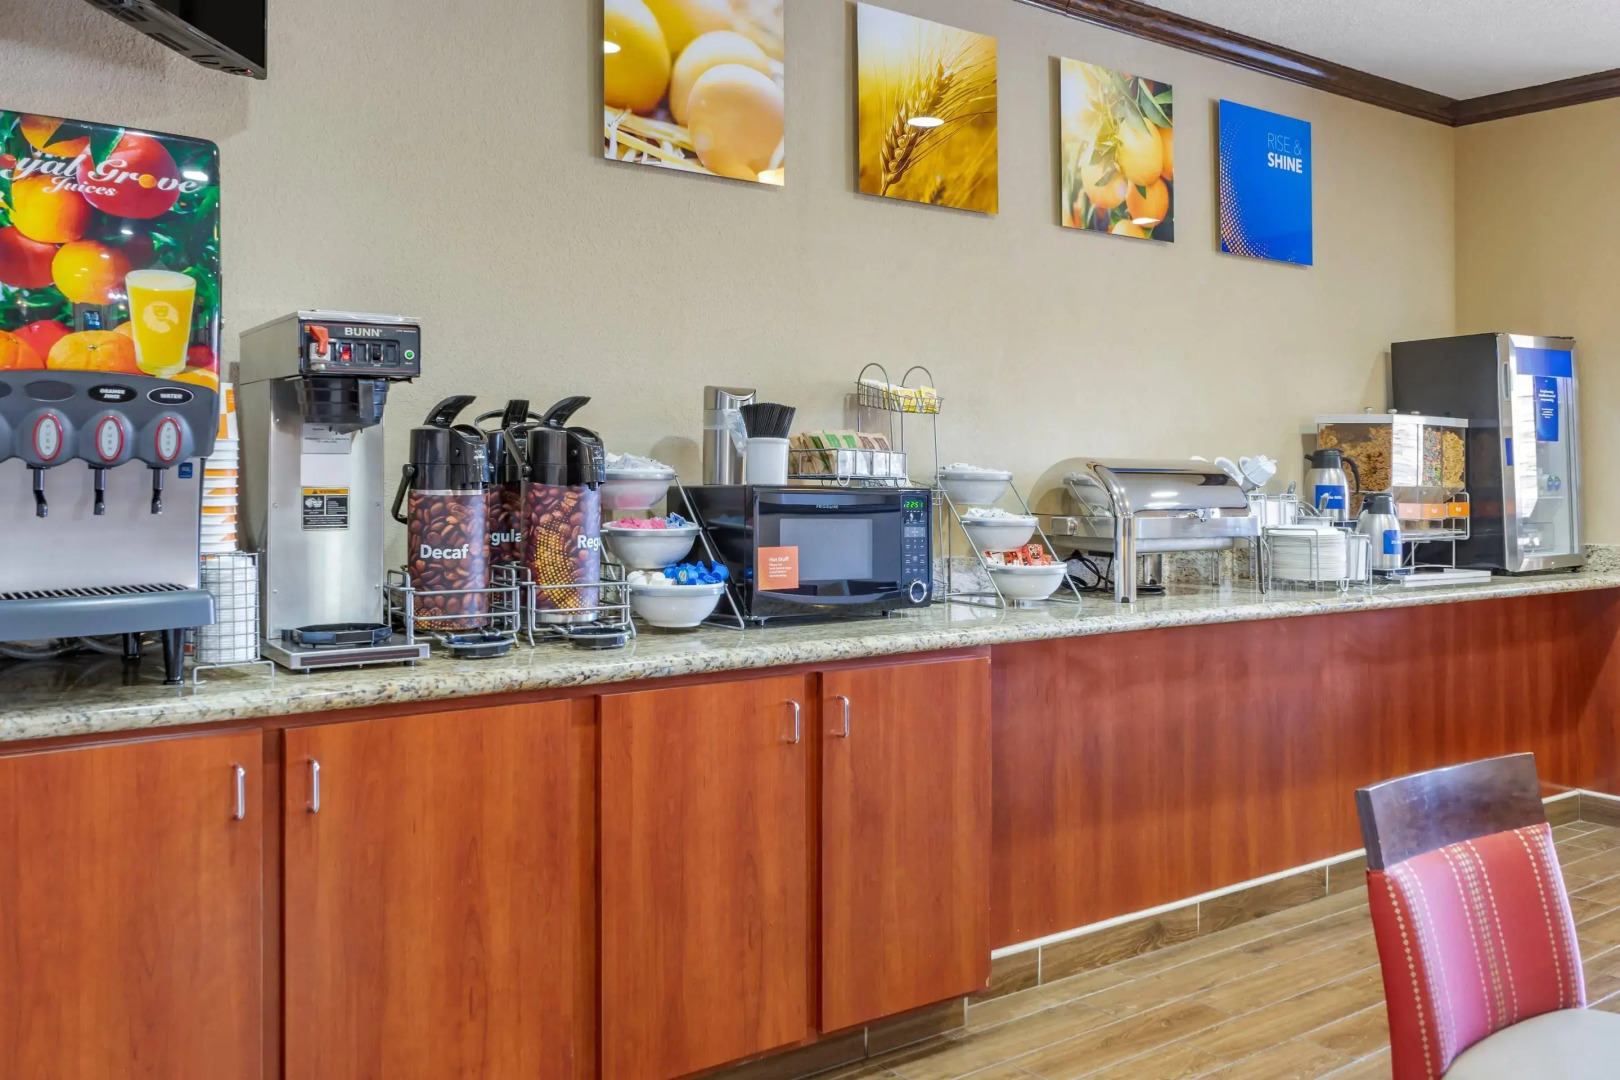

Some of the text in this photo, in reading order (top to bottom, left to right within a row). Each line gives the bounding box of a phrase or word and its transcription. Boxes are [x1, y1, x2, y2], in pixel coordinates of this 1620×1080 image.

[1267, 132, 1302, 156] RISE &
[1267, 152, 1303, 174] SHINE
[42, 176, 119, 196] Juices
[344, 327, 381, 337] BUNN
[489, 528, 522, 546] gula
[577, 534, 601, 552] Reg
[420, 544, 469, 559] Decaf
